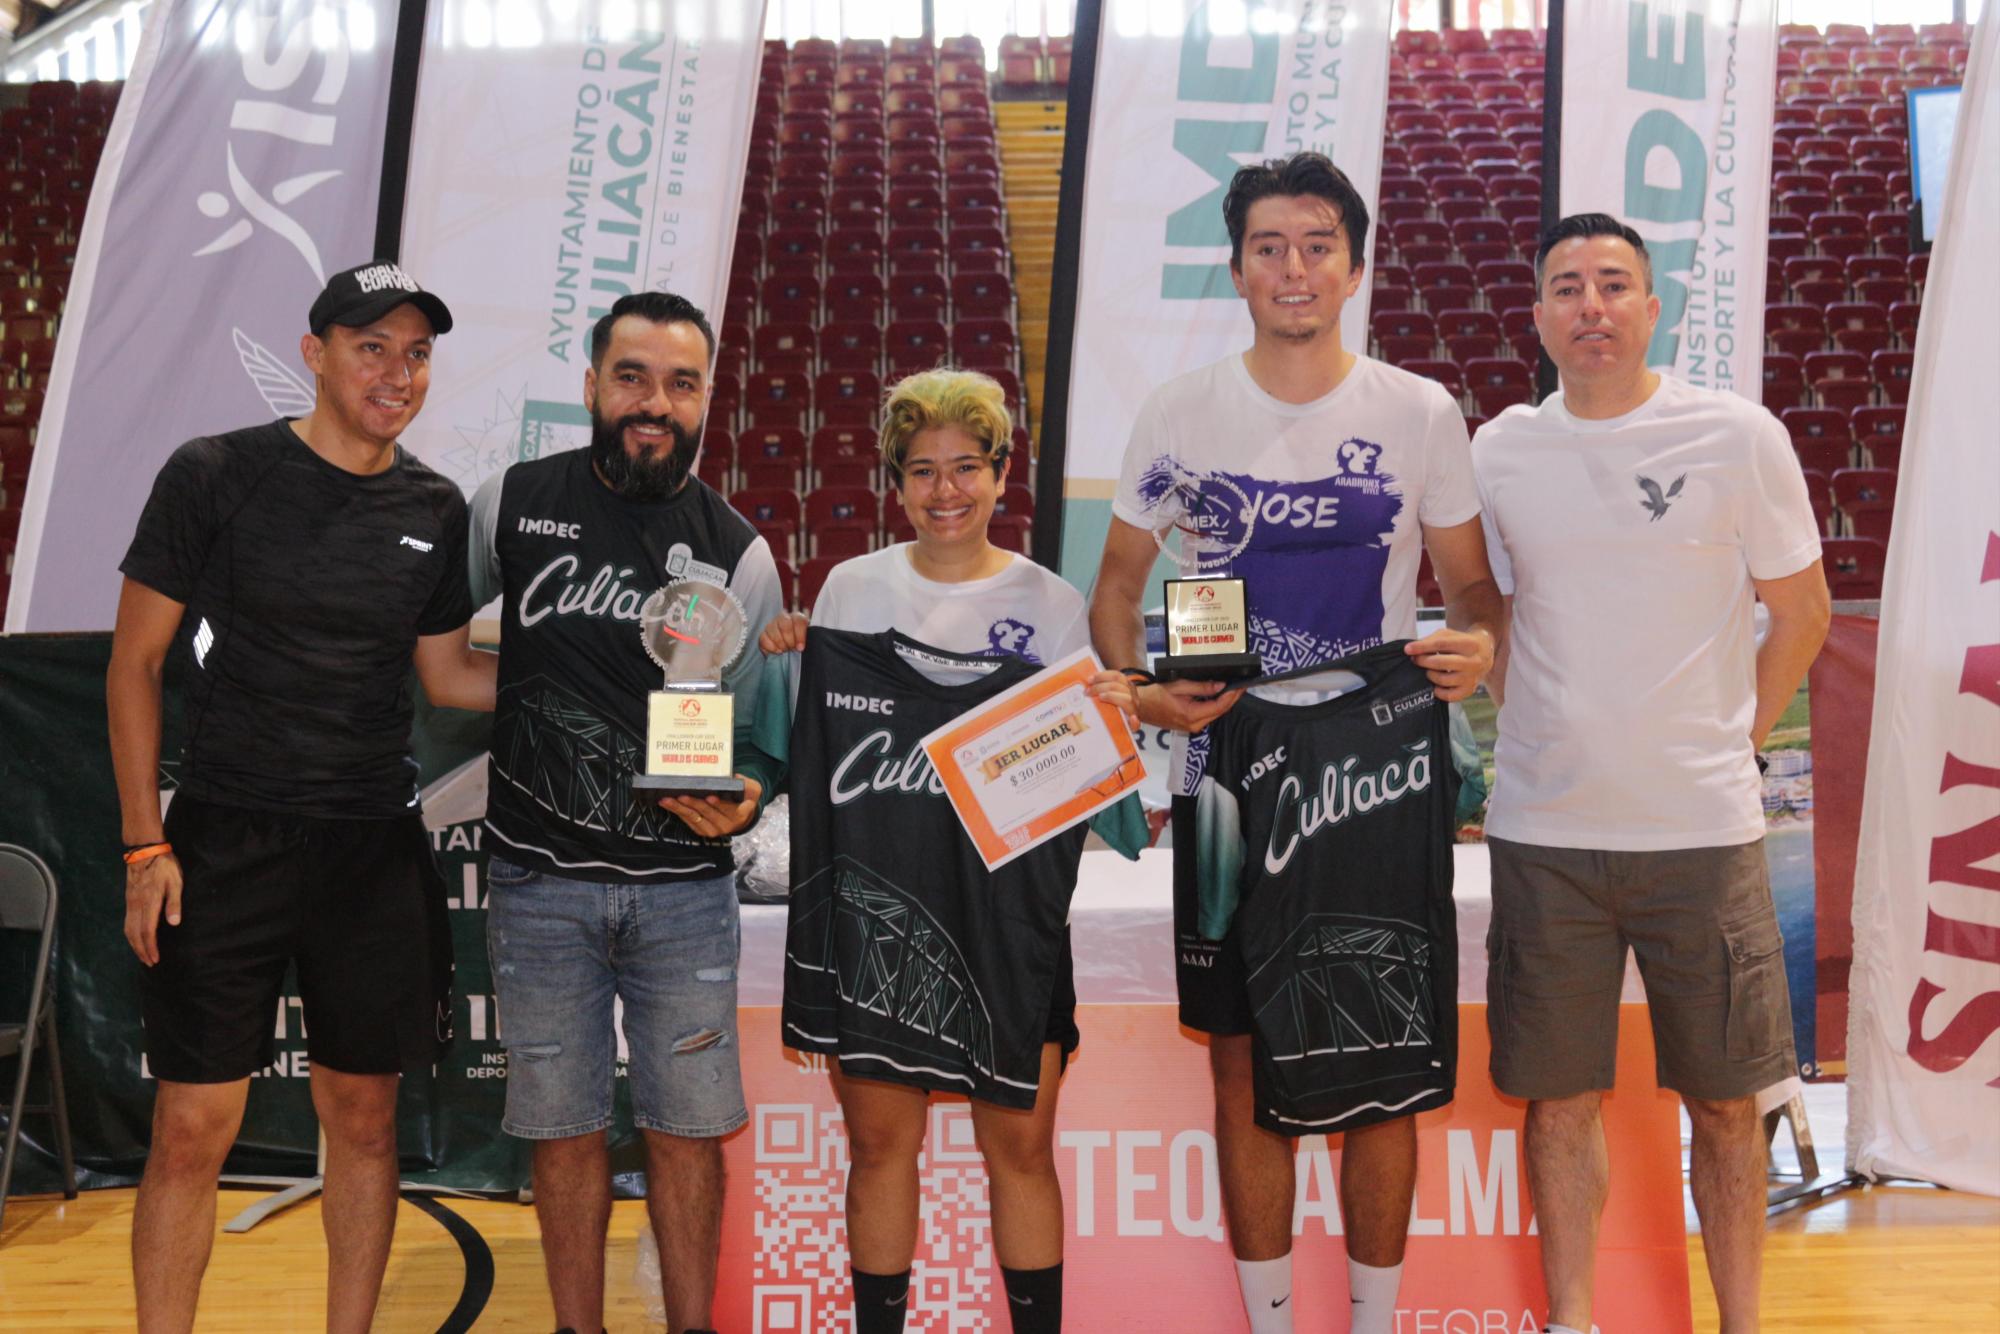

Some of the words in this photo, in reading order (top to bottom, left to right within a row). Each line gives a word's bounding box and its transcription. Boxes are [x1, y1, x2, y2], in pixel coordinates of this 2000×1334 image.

[1317, 58, 1341, 100] LA
[1284, 92, 1309, 158] UTO
[1313, 111, 1336, 132] Y
[582, 31, 665, 363] ULIACÁN
[1715, 187, 1735, 227] LA
[548, 84, 604, 363] AYUNTAMIENTO
[661, 211, 680, 245] DE
[1715, 238, 1734, 257] Y
[1688, 220, 1706, 386] INSTITU
[518, 517, 581, 540] IMDEC
[1175, 624, 1208, 633] PRIMER
[1210, 622, 1239, 632] LUGAR
[826, 692, 895, 715] IMDEC
[1393, 691, 1435, 712] CULIAC
[656, 740, 691, 751] PRIMER
[693, 741, 725, 752] LUGAR
[994, 749, 1021, 770] 1ER
[1021, 722, 1072, 755] LUGAR
[1241, 745, 1288, 791] IDEC
[466, 1067, 507, 1079] DEPO
